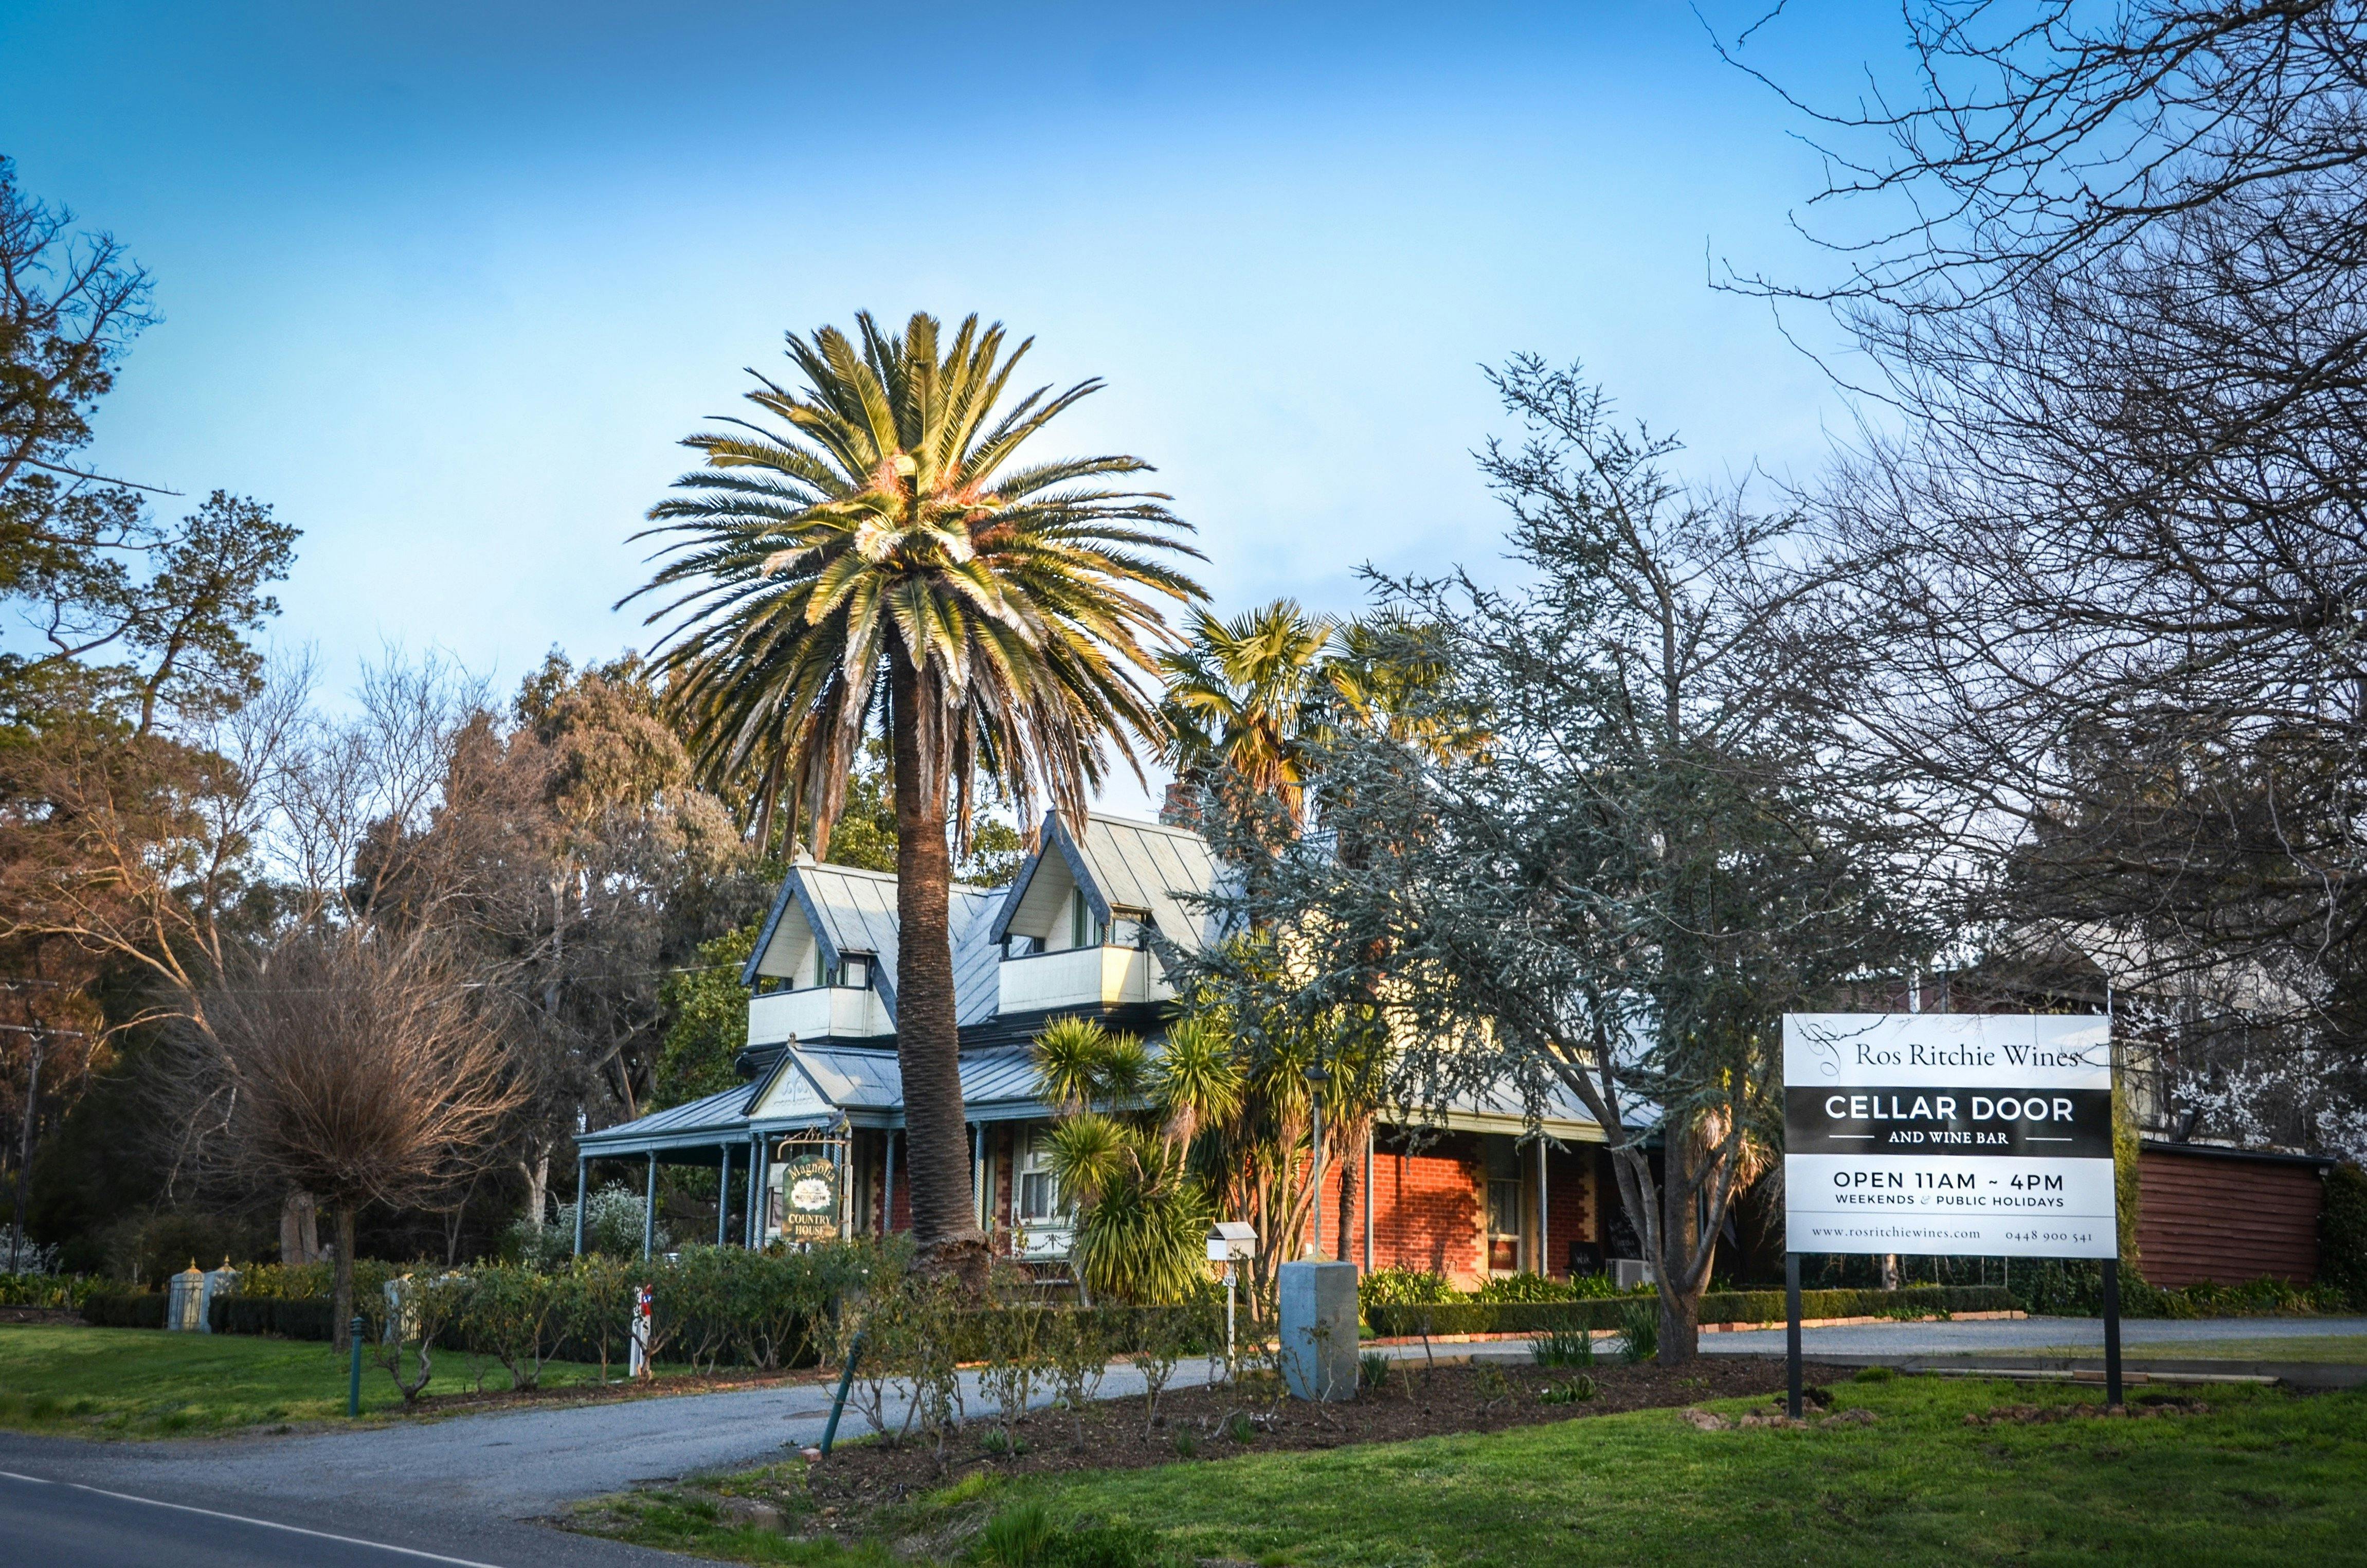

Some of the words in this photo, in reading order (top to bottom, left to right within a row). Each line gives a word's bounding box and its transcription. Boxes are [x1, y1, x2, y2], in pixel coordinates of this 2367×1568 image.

[1855, 1043, 1901, 1066] Ros
[1909, 1043, 1995, 1066] Ritchie
[2002, 1044, 2079, 1067] Wines
[1825, 1095, 1957, 1121] CELLAR
[1972, 1096, 2073, 1122] DOOR
[1888, 1131, 1924, 1144] AND
[1928, 1131, 1972, 1144] WINE
[1976, 1132, 2009, 1145] BAR
[788, 1163, 835, 1182] Magnolia
[1833, 1171, 1903, 1188] OPEN
[1914, 1173, 1975, 1189] 11AM
[2010, 1174, 2063, 1191] 4PM
[1835, 1194, 1914, 1205] WEEKENDS
[1937, 1195, 1986, 1206] PUBLIC
[1993, 1196, 2064, 1207] HOLIDAYS
[788, 1213, 832, 1224] COUNTRY
[1812, 1225, 1980, 1239] www.rosritchiewines.com
[2005, 1230, 2038, 1242] 0448
[2043, 1233, 2067, 1242] 900
[2073, 1233, 2092, 1243] 541
